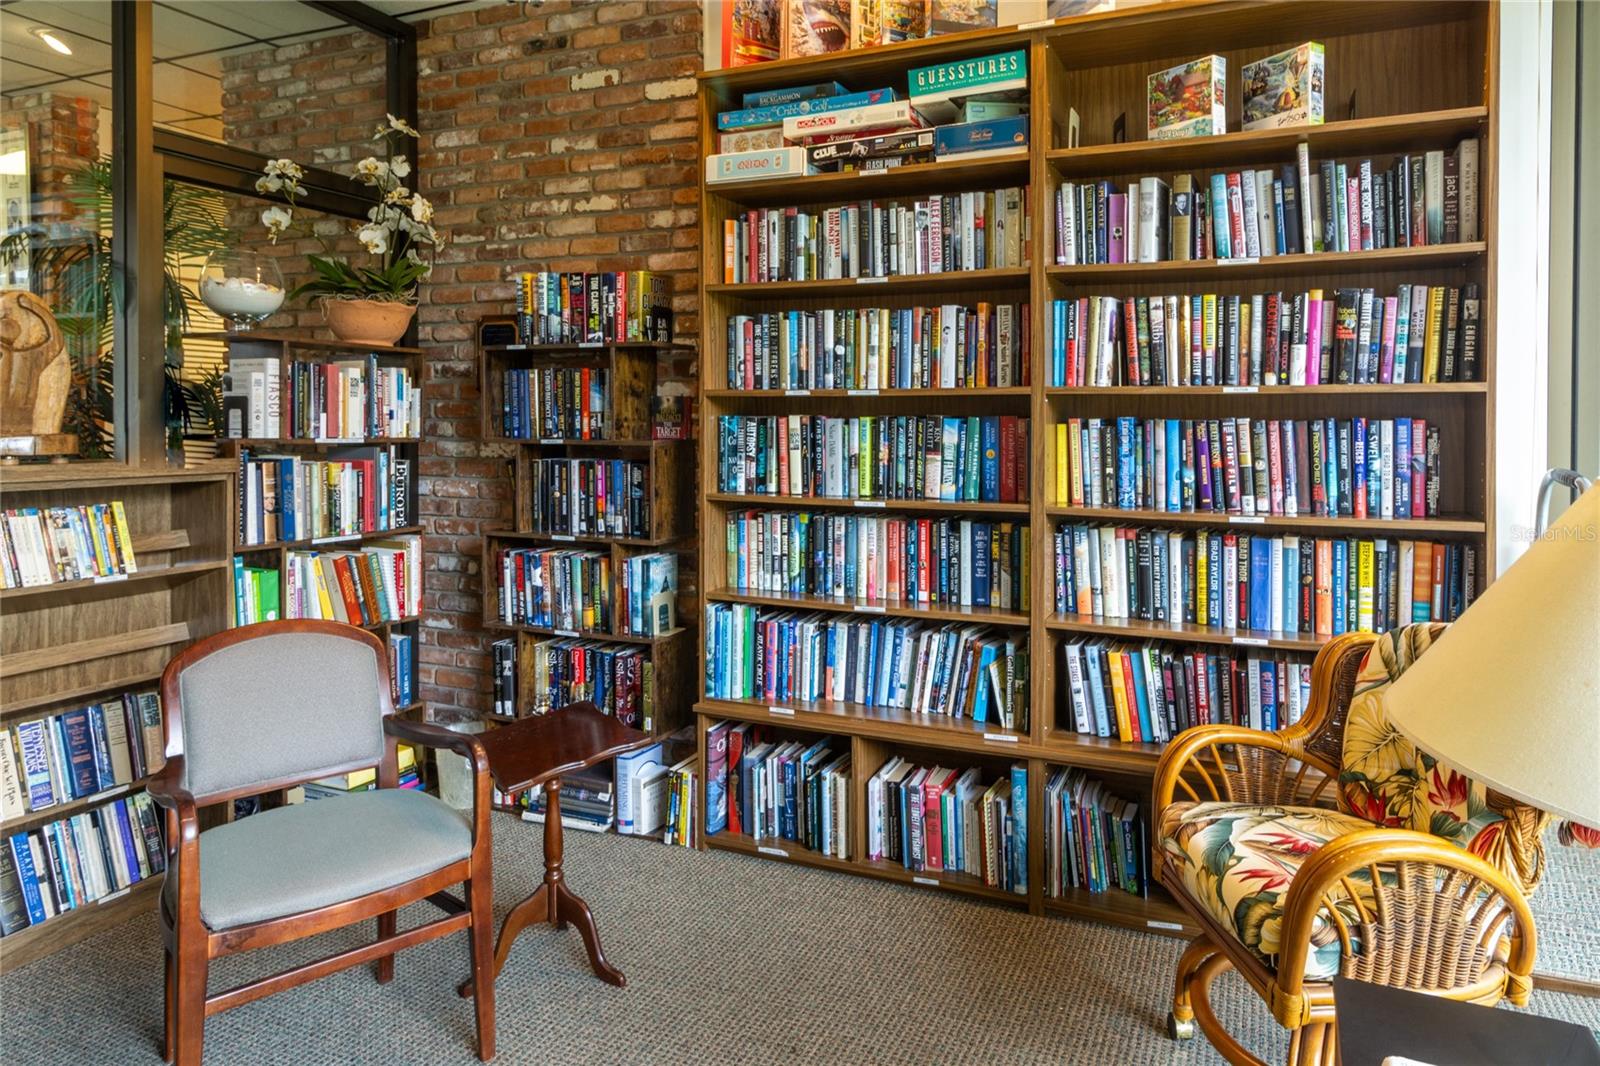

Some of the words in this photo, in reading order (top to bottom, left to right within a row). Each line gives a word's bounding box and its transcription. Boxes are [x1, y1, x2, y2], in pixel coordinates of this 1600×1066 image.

[918, 56, 1017, 85] GUESSTURES
[797, 116, 836, 128] MONOPOLY
[813, 146, 837, 159] CLUE
[866, 158, 882, 170] FLASH
[885, 157, 902, 168] POINT
[1244, 174, 1252, 199] KEVIN
[1360, 162, 1370, 190] WAYNE
[1445, 175, 1458, 197] jack
[931, 200, 941, 218] ALEX
[1361, 192, 1371, 224] ROONEY
[931, 222, 941, 263] FERGUSON
[1245, 208, 1258, 257] PIETERSEN
[590, 277, 598, 290] TOM
[1450, 288, 1458, 304] STEVE
[591, 291, 599, 315] CLANCY
[1267, 295, 1277, 335] KOONTZ
[1126, 320, 1138, 357] JOHANSEN
[1152, 319, 1163, 343] Alibi
[1447, 331, 1455, 350] TRADER
[1464, 325, 1474, 361] ENDGAME
[770, 346, 778, 378] BEHRENS
[1192, 352, 1200, 375] MYSTERY
[1445, 355, 1454, 376] SECRETS
[269, 374, 279, 418] FIASCO
[656, 427, 680, 438] TARGET
[746, 421, 756, 457] AUTOPSY
[927, 421, 935, 448] FOLLETT
[1226, 435, 1234, 466] NIGHT
[1355, 442, 1364, 464] REICHS
[1368, 435, 1378, 465] SWELL
[1228, 469, 1236, 493] FILM
[396, 464, 407, 527] EUROPE
[1362, 544, 1370, 568] STEPHEN
[1239, 561, 1247, 582] THOR
[1070, 665, 1079, 682] STAKES
[1198, 675, 1206, 705] LEIBOVICH
[21, 727, 37, 773] WILLIAMS
[32, 724, 48, 772] TENNESSEE
[911, 794, 919, 804] THE
[912, 829, 921, 859] POLYGAMIST
[21, 844, 34, 877] PLAYS
